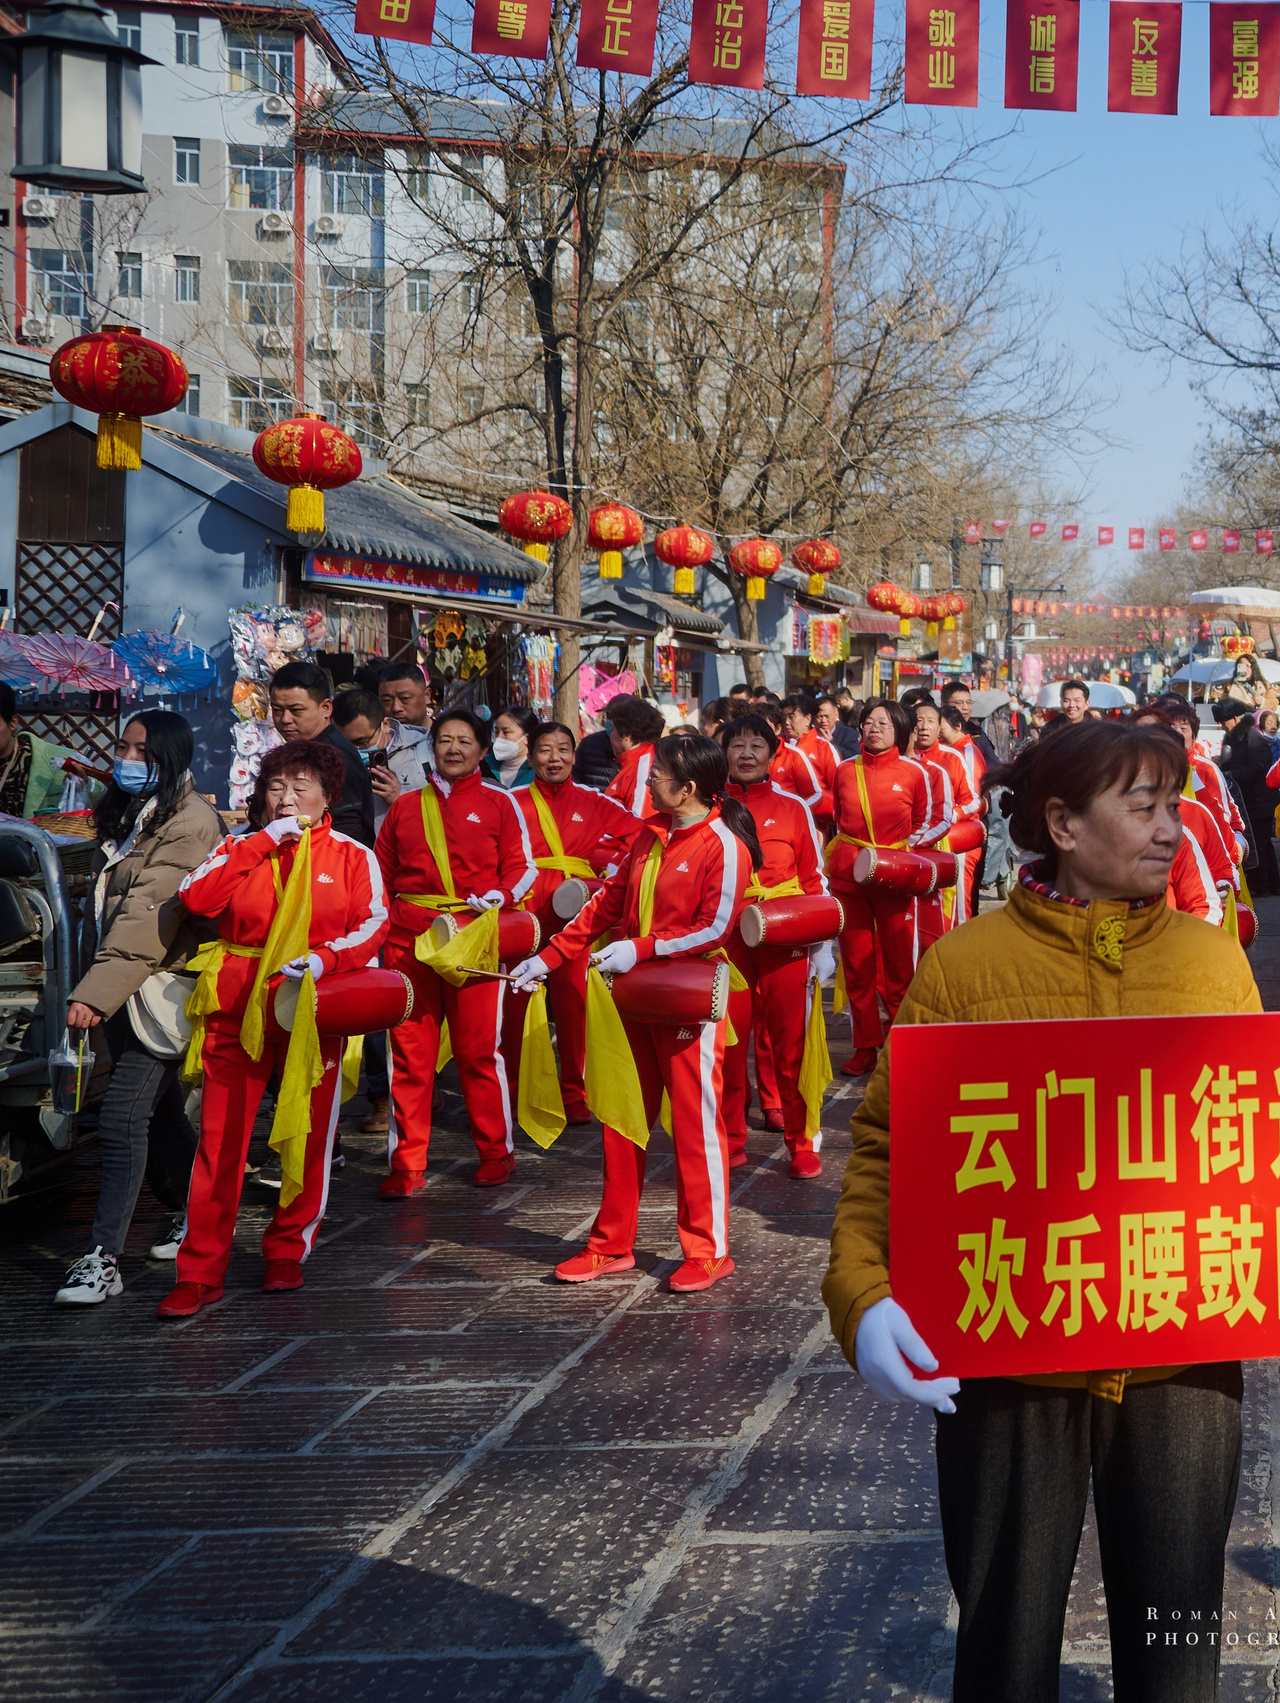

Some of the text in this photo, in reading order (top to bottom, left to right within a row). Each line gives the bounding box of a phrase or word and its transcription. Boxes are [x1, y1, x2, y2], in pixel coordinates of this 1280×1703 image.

[712, 0, 743, 70] 法治
[820, 1, 850, 81] 爱国
[928, 9, 956, 89] 敬业
[1029, 14, 1057, 94] 诚信
[1131, 17, 1159, 97] 友善
[1232, 19, 1259, 99] 富强
